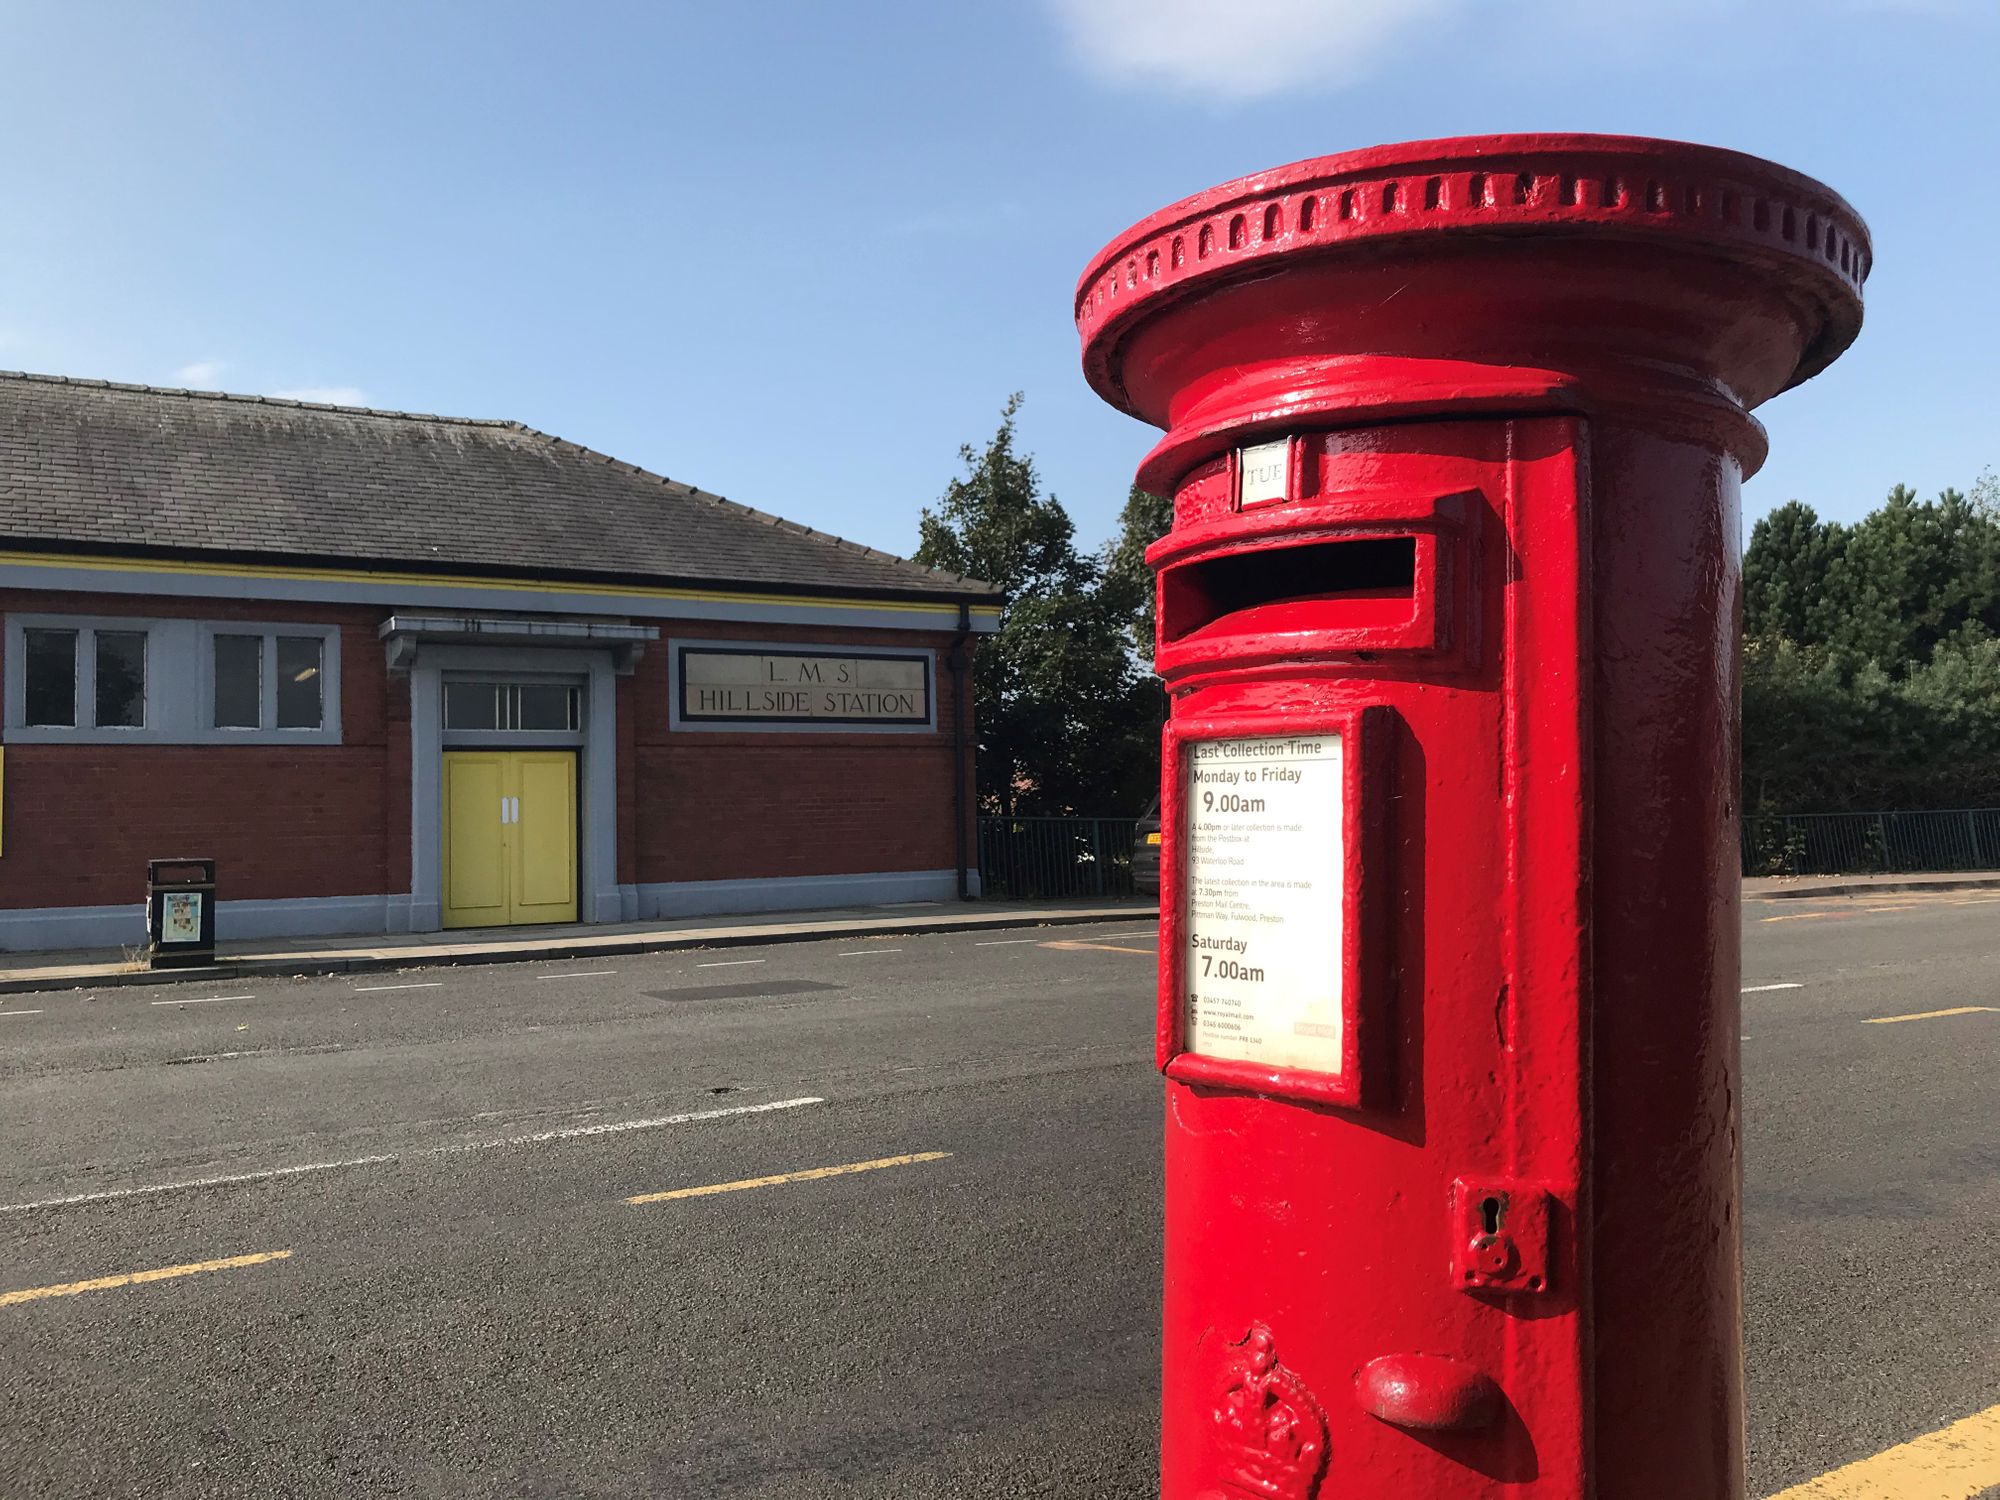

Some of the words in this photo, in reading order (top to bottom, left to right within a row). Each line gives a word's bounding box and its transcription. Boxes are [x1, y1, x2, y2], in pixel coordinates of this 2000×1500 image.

[1247, 463, 1282, 486] TUE
[699, 690, 810, 712] HILLSIDE
[1193, 743, 1219, 759] Last
[1223, 742, 1284, 758] Collection
[1288, 740, 1322, 755] Time
[1193, 769, 1240, 785] Monday
[1244, 769, 1257, 782] to
[1261, 767, 1302, 784] Friday
[1203, 791, 1265, 812] 9.00am
[1192, 823, 1197, 831] A
[1198, 823, 1222, 832] 4.00pm
[1192, 856, 1200, 865] 93
[1192, 876, 1203, 885] The
[1204, 876, 1220, 886] latest
[1221, 877, 1250, 887] collection
[1199, 888, 1223, 898] 7.30pm
[1224, 888, 1239, 897] from
[1259, 913, 1284, 924] Preston
[1192, 934, 1248, 954] Saturday
[1201, 955, 1265, 982] 7.00am
[1203, 1010, 1254, 1021] www.royalmail.com
